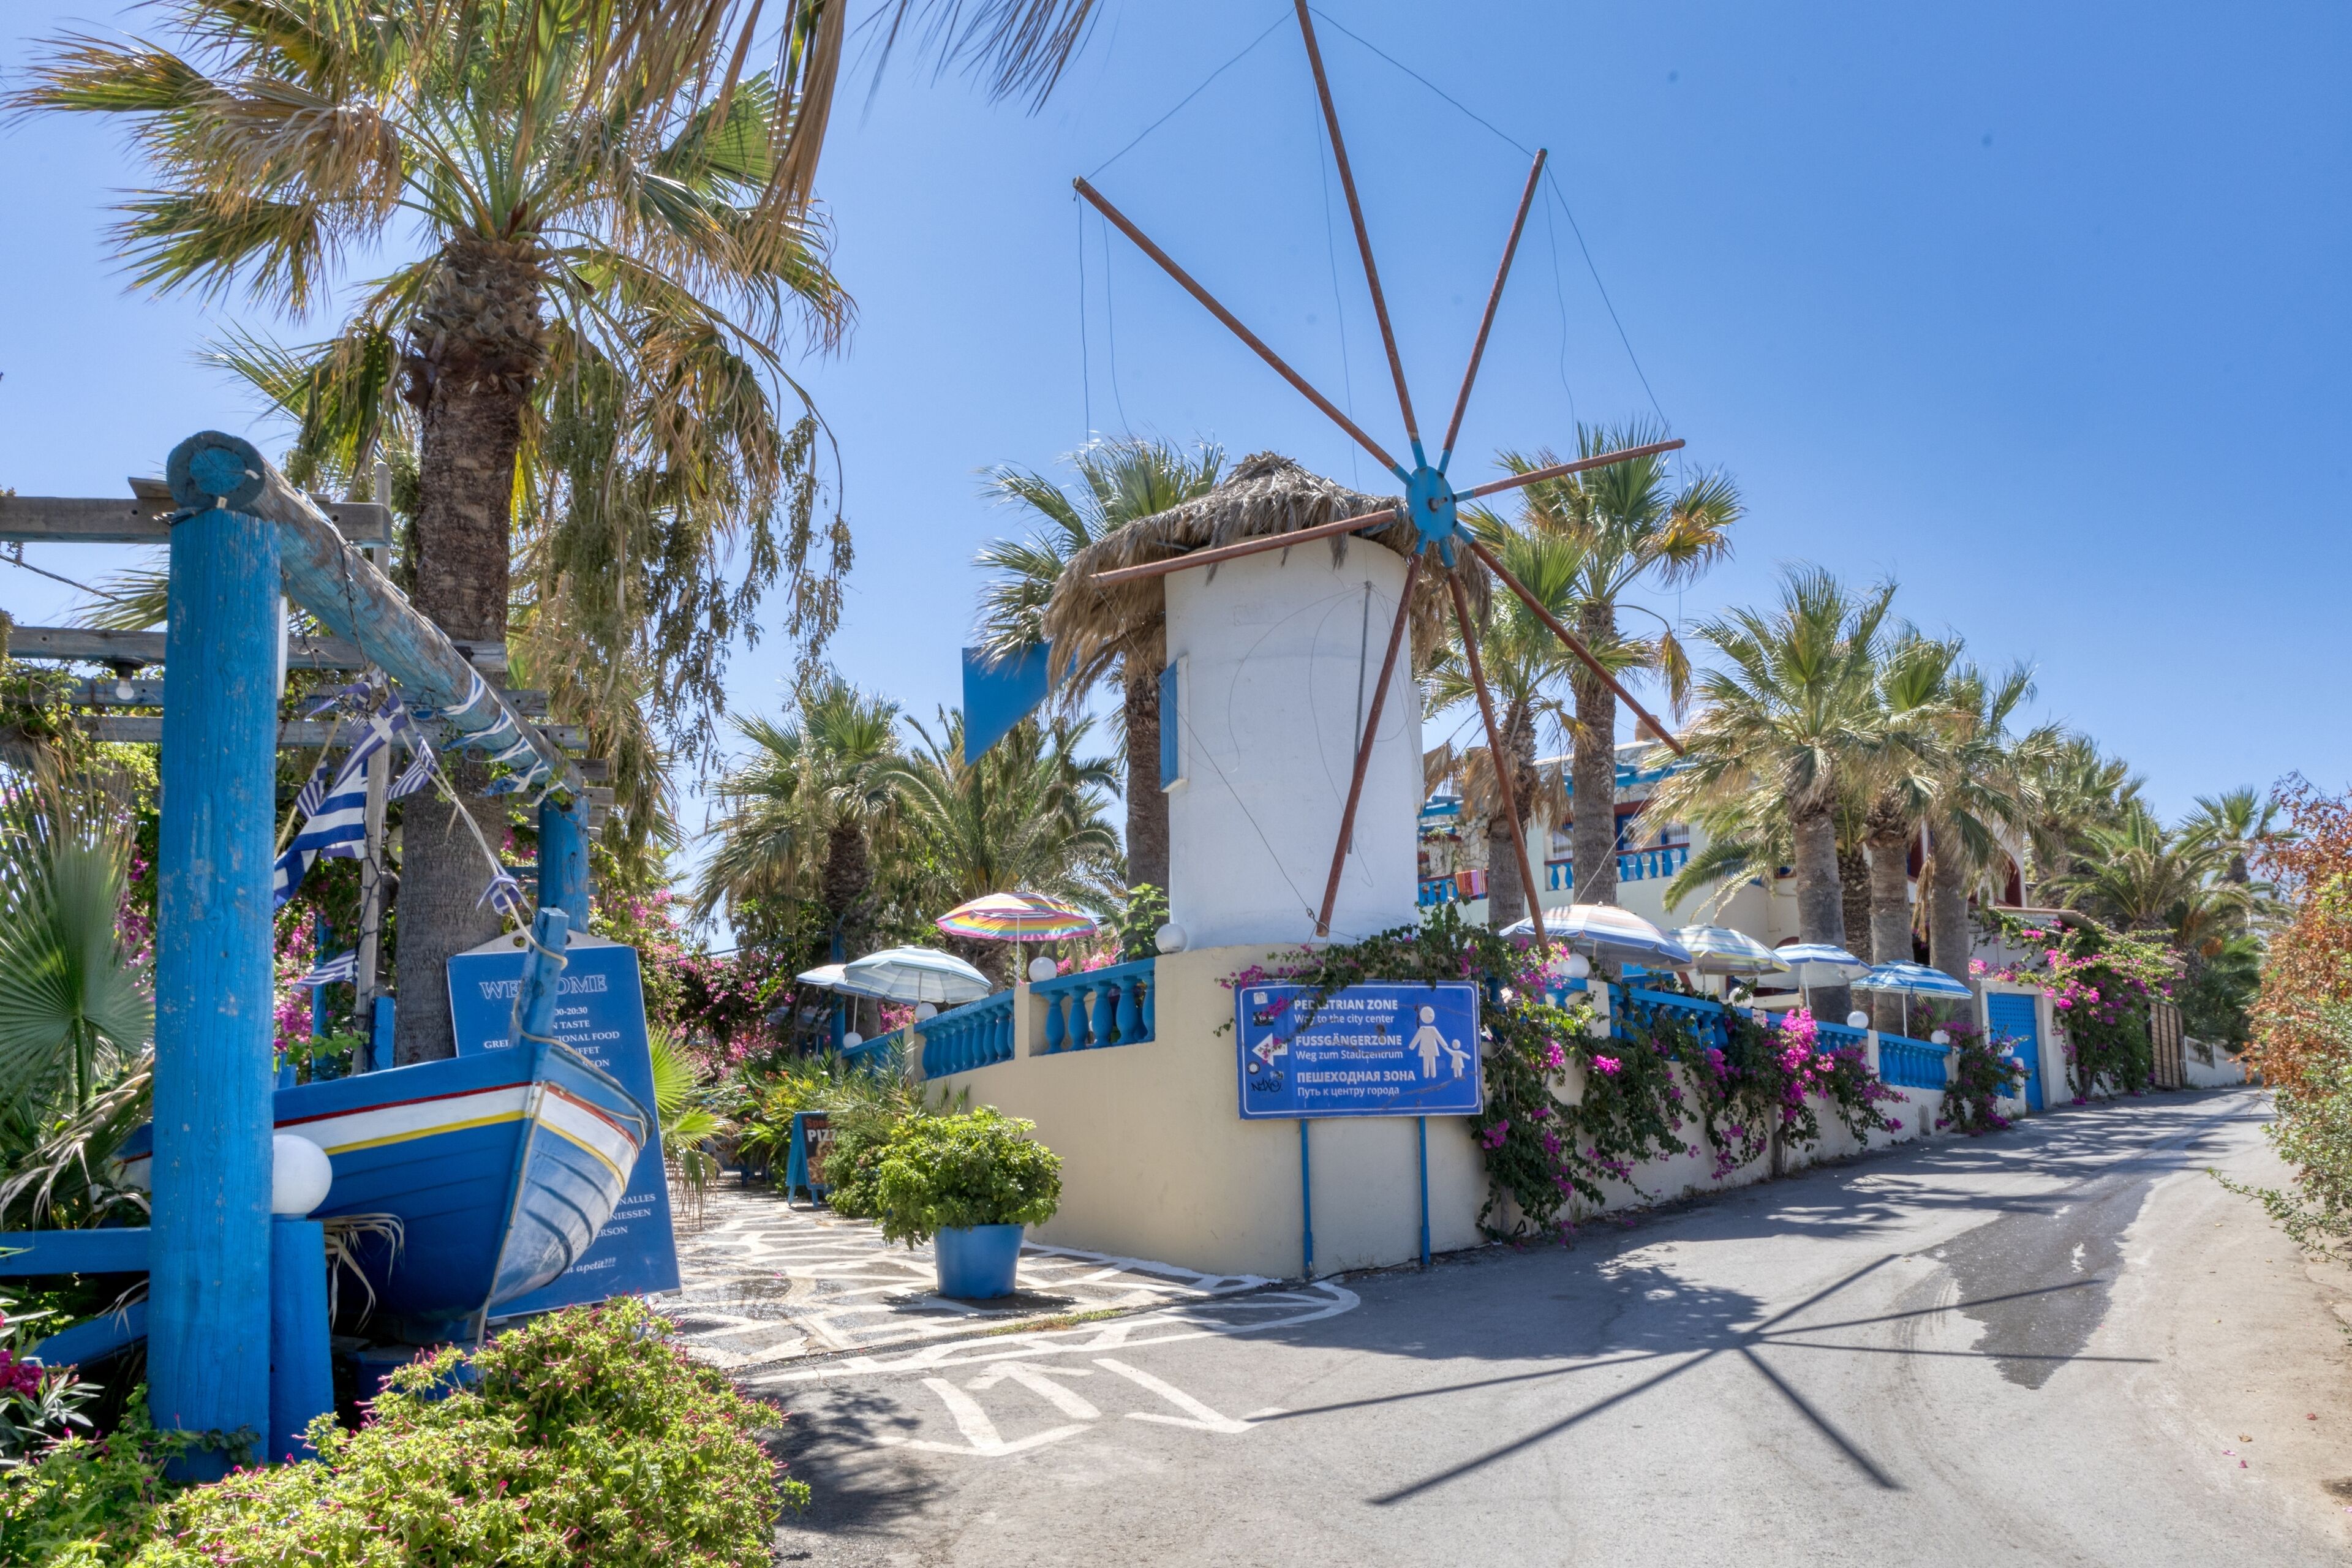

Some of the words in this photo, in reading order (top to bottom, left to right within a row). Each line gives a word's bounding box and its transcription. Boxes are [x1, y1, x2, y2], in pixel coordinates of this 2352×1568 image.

[478, 974, 608, 1000] WEOME
[1366, 999, 1398, 1010] ZONE
[560, 1019, 590, 1029] TASTE
[1317, 1014, 1327, 1023] to
[1329, 1014, 1344, 1023] the
[1347, 1014, 1363, 1025] city
[1365, 1015, 1395, 1023] center
[592, 1031, 620, 1041] FOOD
[1295, 1033, 1403, 1047] FUSSGÄNGERZONE
[1295, 1050, 1317, 1062] Weg
[1341, 1049, 1403, 1060] Stadtzentrum
[1297, 1071, 1381, 1084] ПЕШЕХОДНАЯ
[1383, 1071, 1416, 1082] ЗОНА
[1297, 1087, 1321, 1098] Путь
[1331, 1087, 1365, 1098] центру
[1367, 1087, 1400, 1097] города
[807, 1129, 838, 1143] PIZZ
[576, 1257, 617, 1274] apetit!!!
